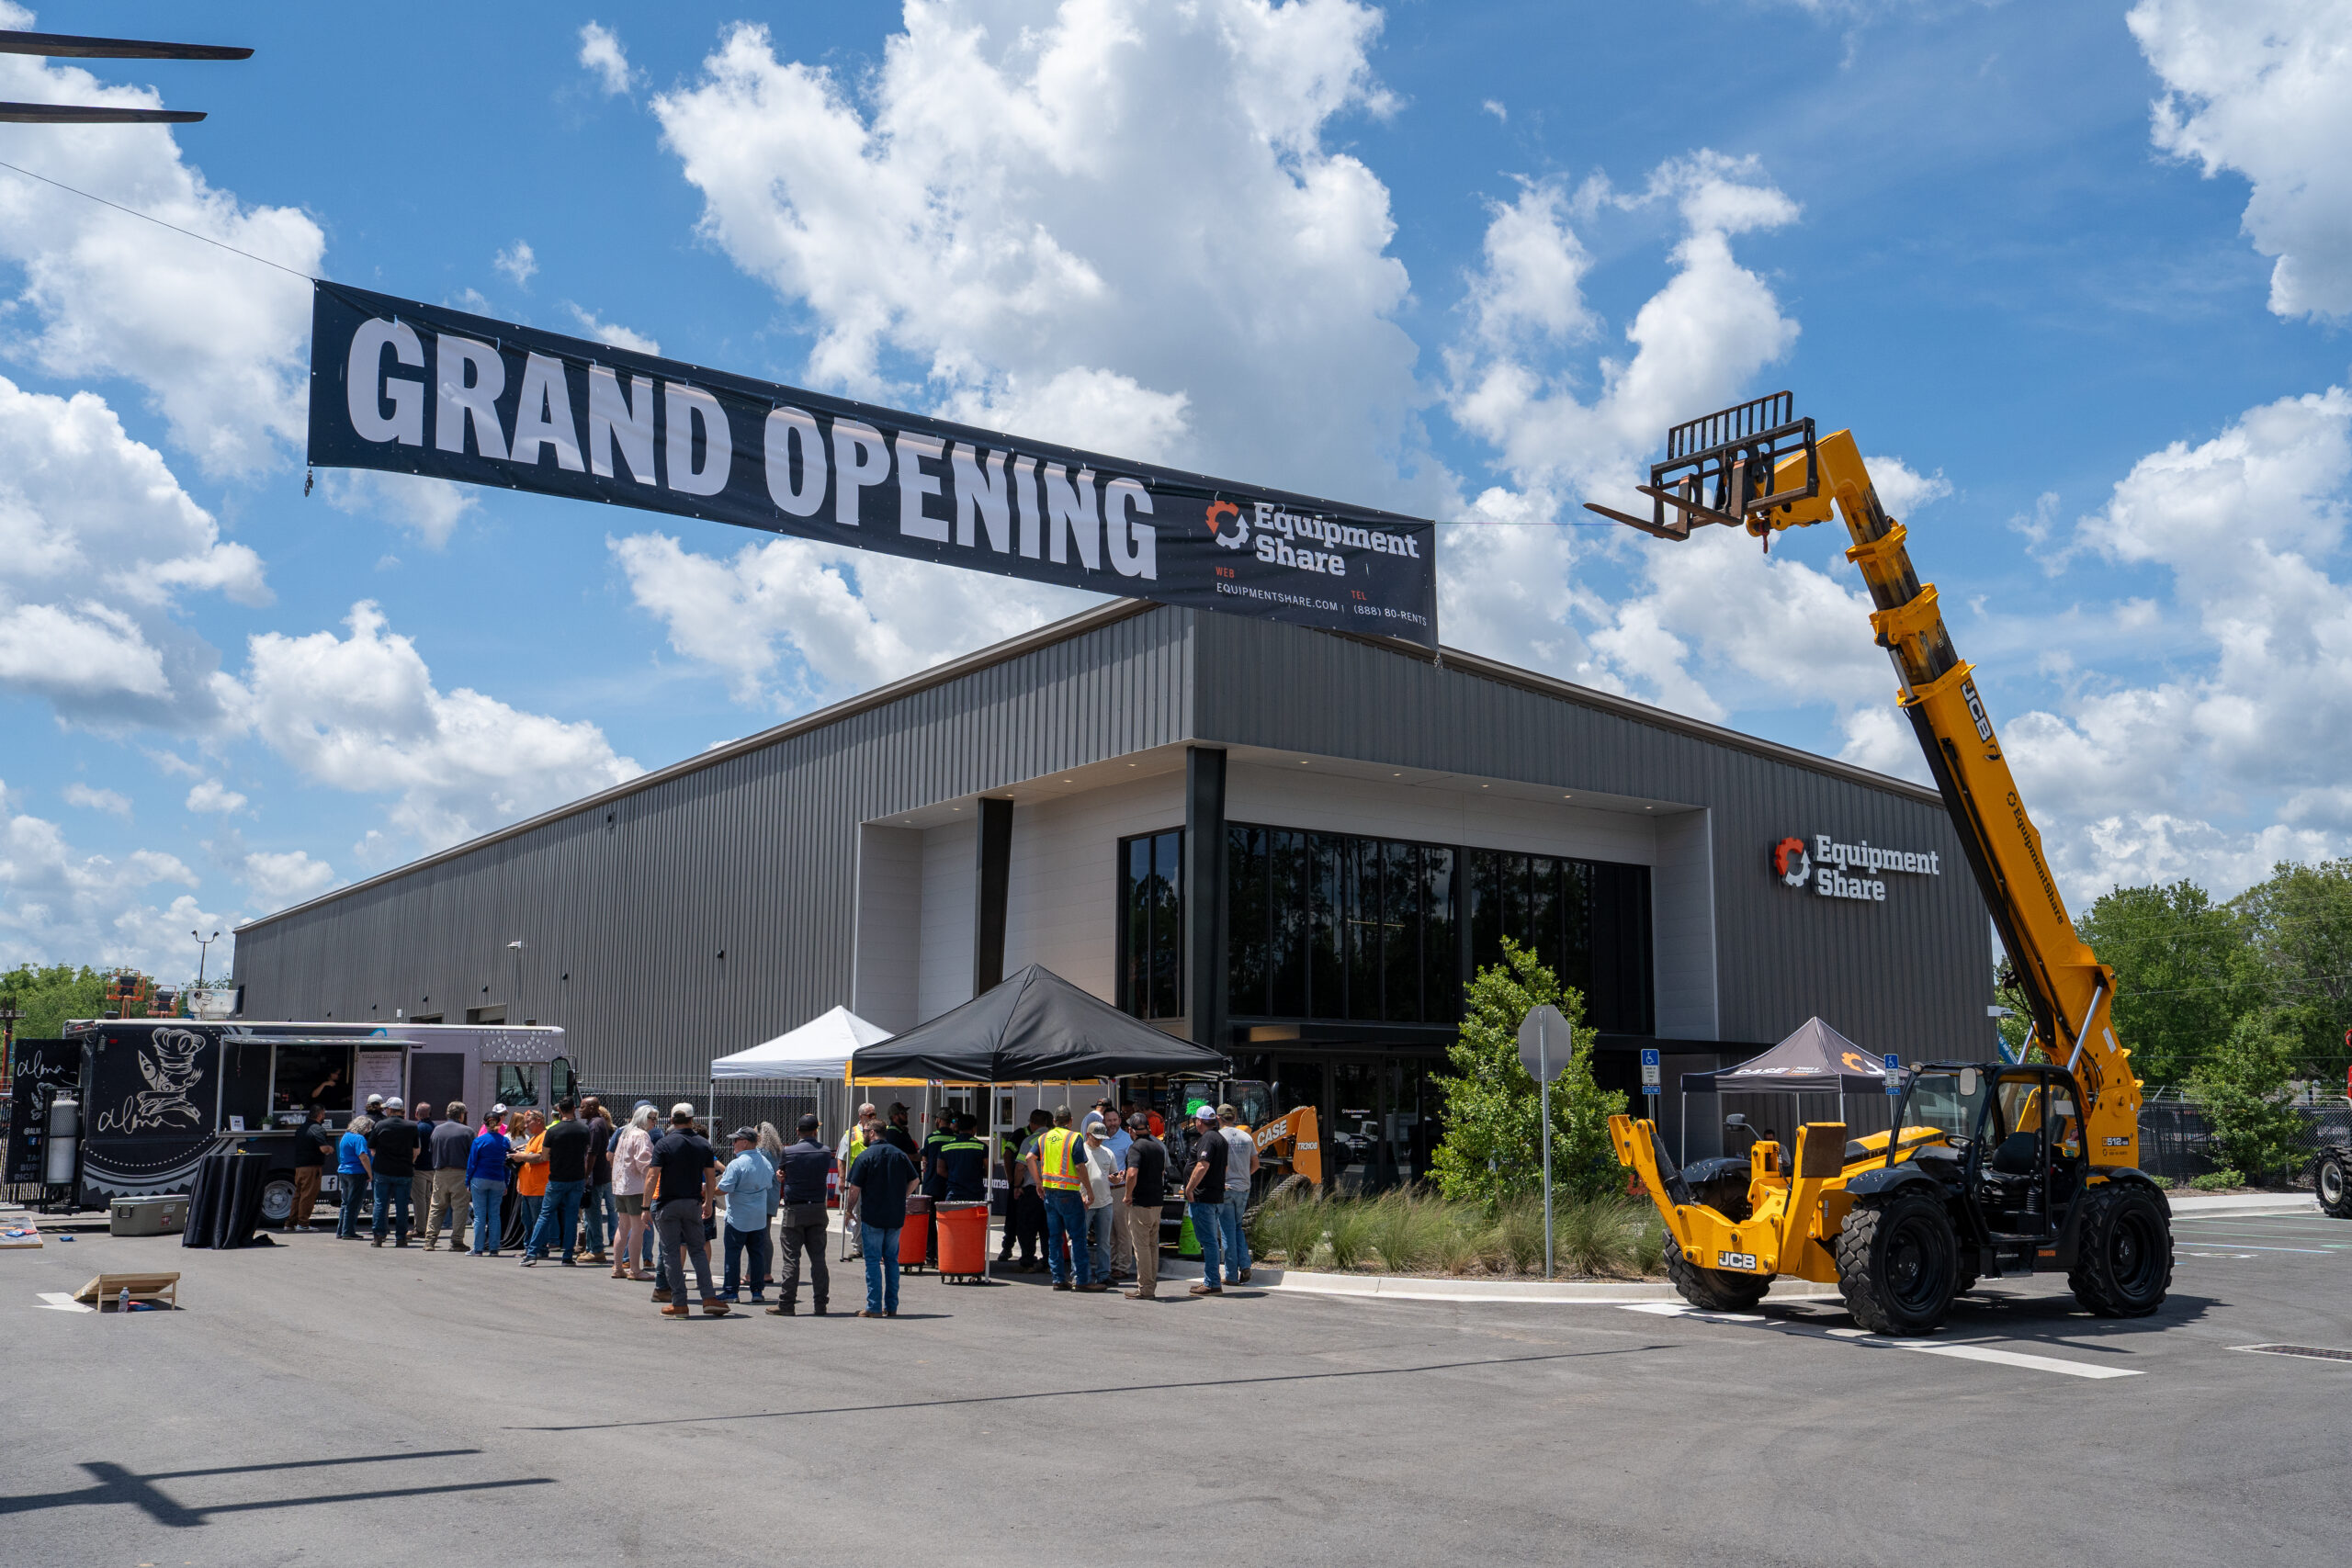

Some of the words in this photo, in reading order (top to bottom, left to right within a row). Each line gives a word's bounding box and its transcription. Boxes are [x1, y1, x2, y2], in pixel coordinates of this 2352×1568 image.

[347, 317, 732, 496] GRAND
[764, 406, 1157, 581] OPENING
[1253, 502, 1419, 558] Equipment
[1216, 566, 1235, 579] WEB
[1255, 535, 1345, 576] Share
[1216, 582, 1338, 611] EQUIPMENTSHARE.COM
[1351, 590, 1367, 601] TEL
[1353, 604, 1381, 616] (888)
[1385, 608, 1427, 626] 80-RENTS
[1962, 682, 1991, 741] JCB
[1815, 834, 1939, 875] Equipment
[2013, 807, 2064, 925] EquipmentShare
[1817, 867, 1885, 901] Share
[1257, 1119, 1287, 1147] CASE
[1719, 1252, 1756, 1269] JCB
